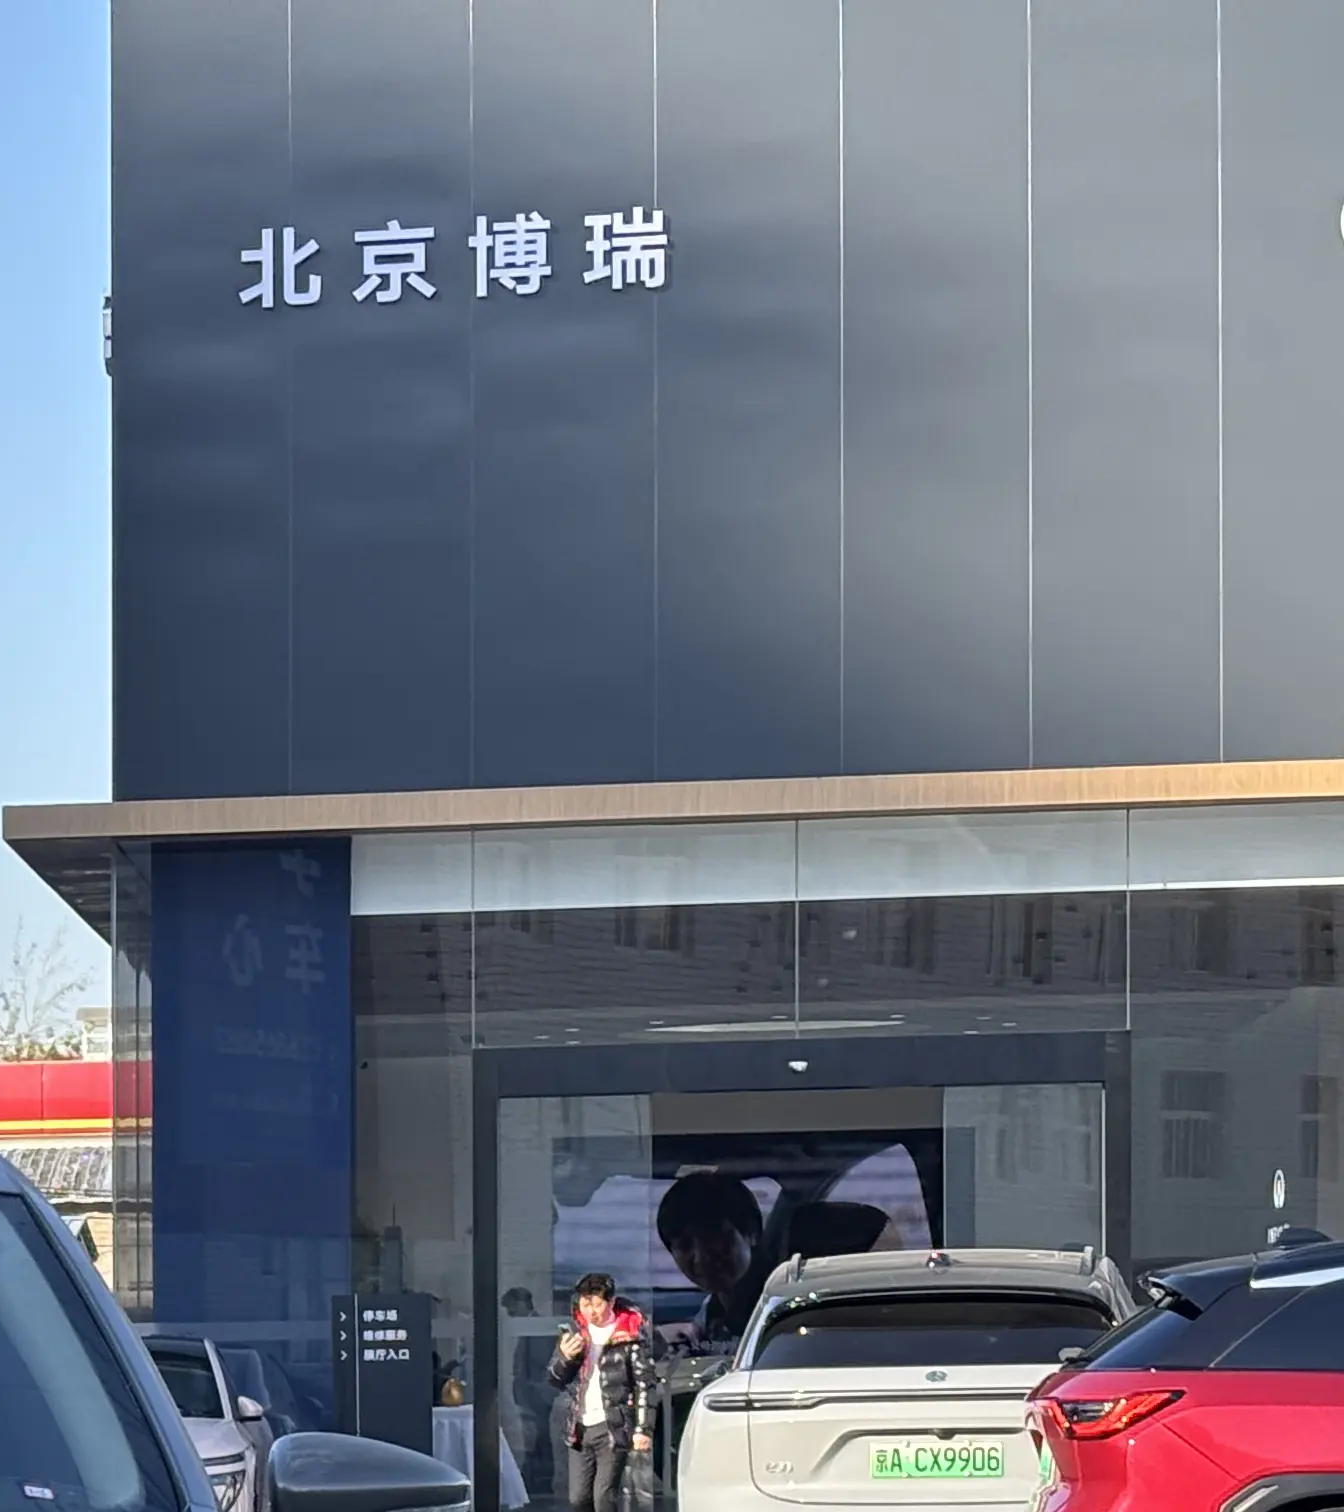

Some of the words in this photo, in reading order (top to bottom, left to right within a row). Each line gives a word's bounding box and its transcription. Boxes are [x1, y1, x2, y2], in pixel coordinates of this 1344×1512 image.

[238, 206, 669, 309] 北京博瑞
[363, 1309, 398, 1322] 停车场
